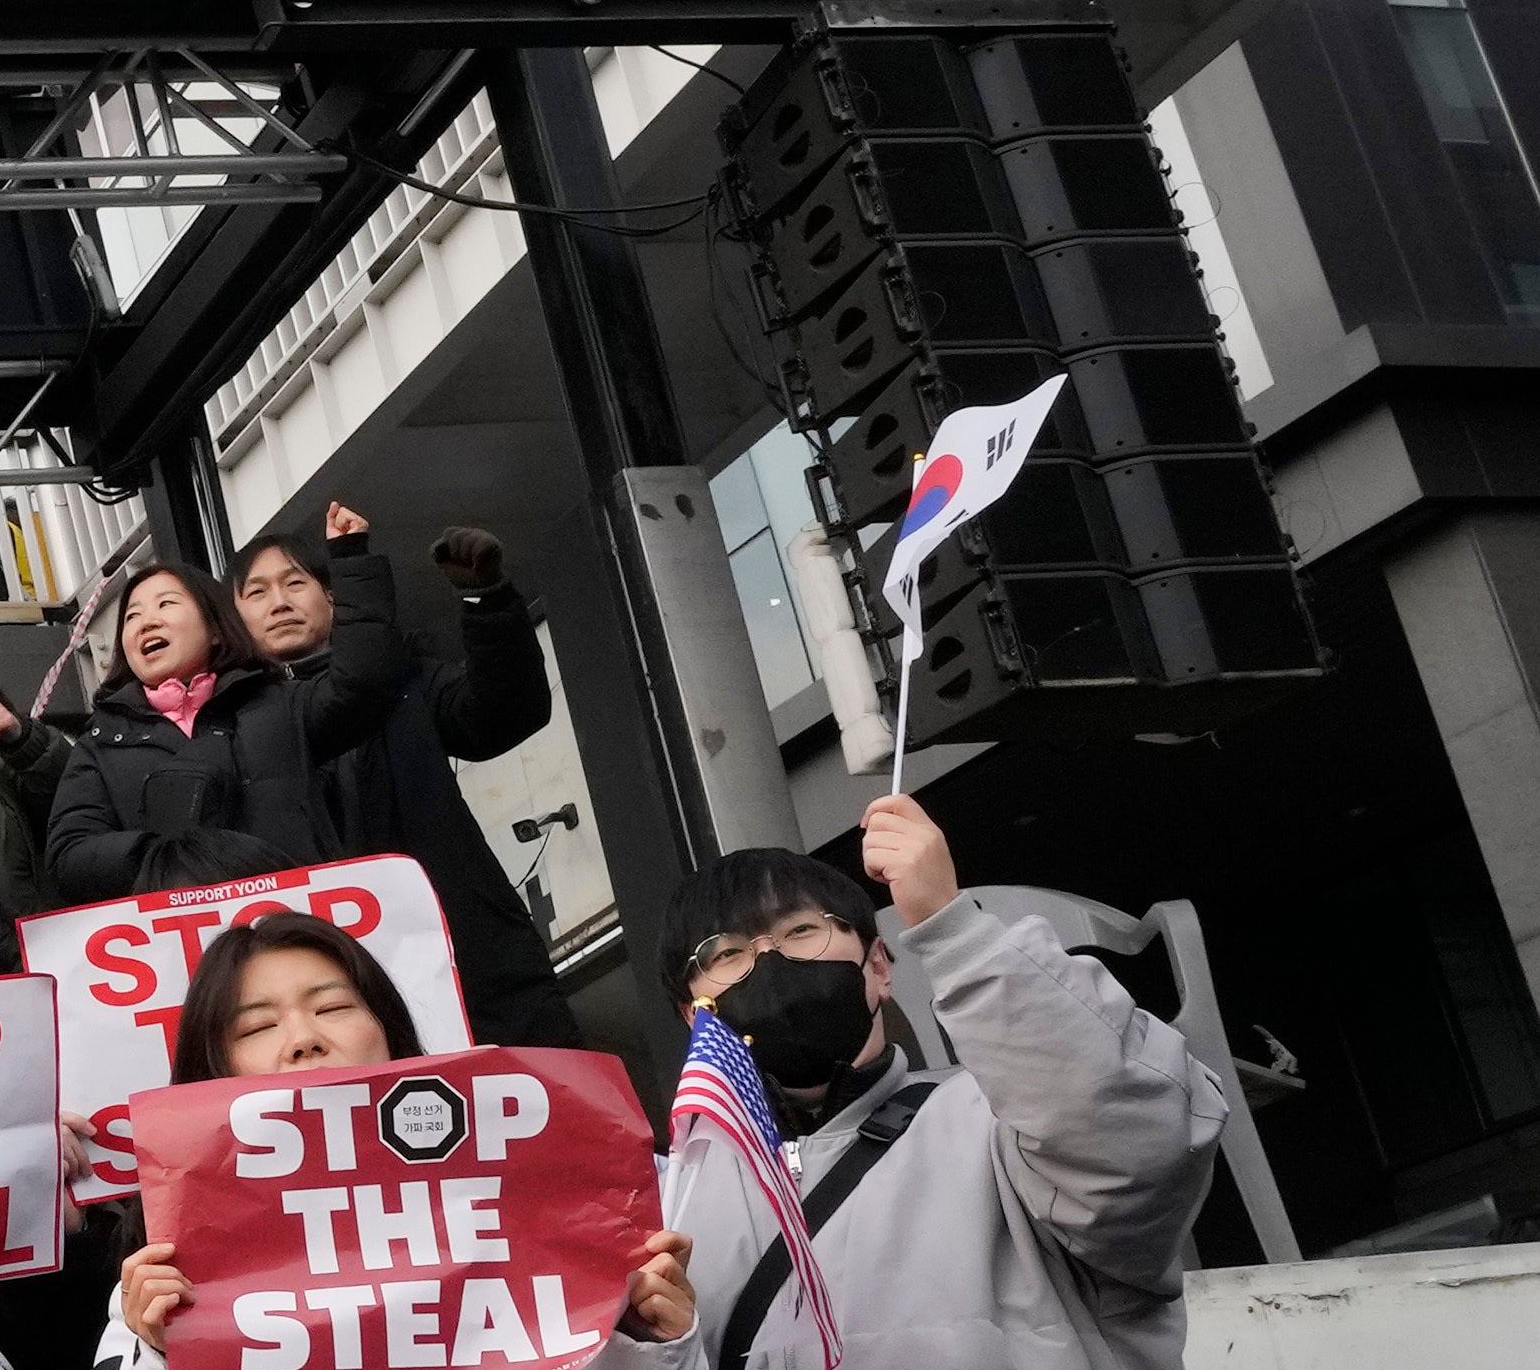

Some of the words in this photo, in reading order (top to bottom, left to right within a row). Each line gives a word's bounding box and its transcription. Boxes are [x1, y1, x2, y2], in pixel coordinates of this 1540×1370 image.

[168, 884, 233, 908] SUPPORT
[234, 876, 279, 898] YOON
[84, 885, 383, 1008] STP
[228, 1072, 550, 1180] STOP
[281, 1178, 510, 1276] THE
